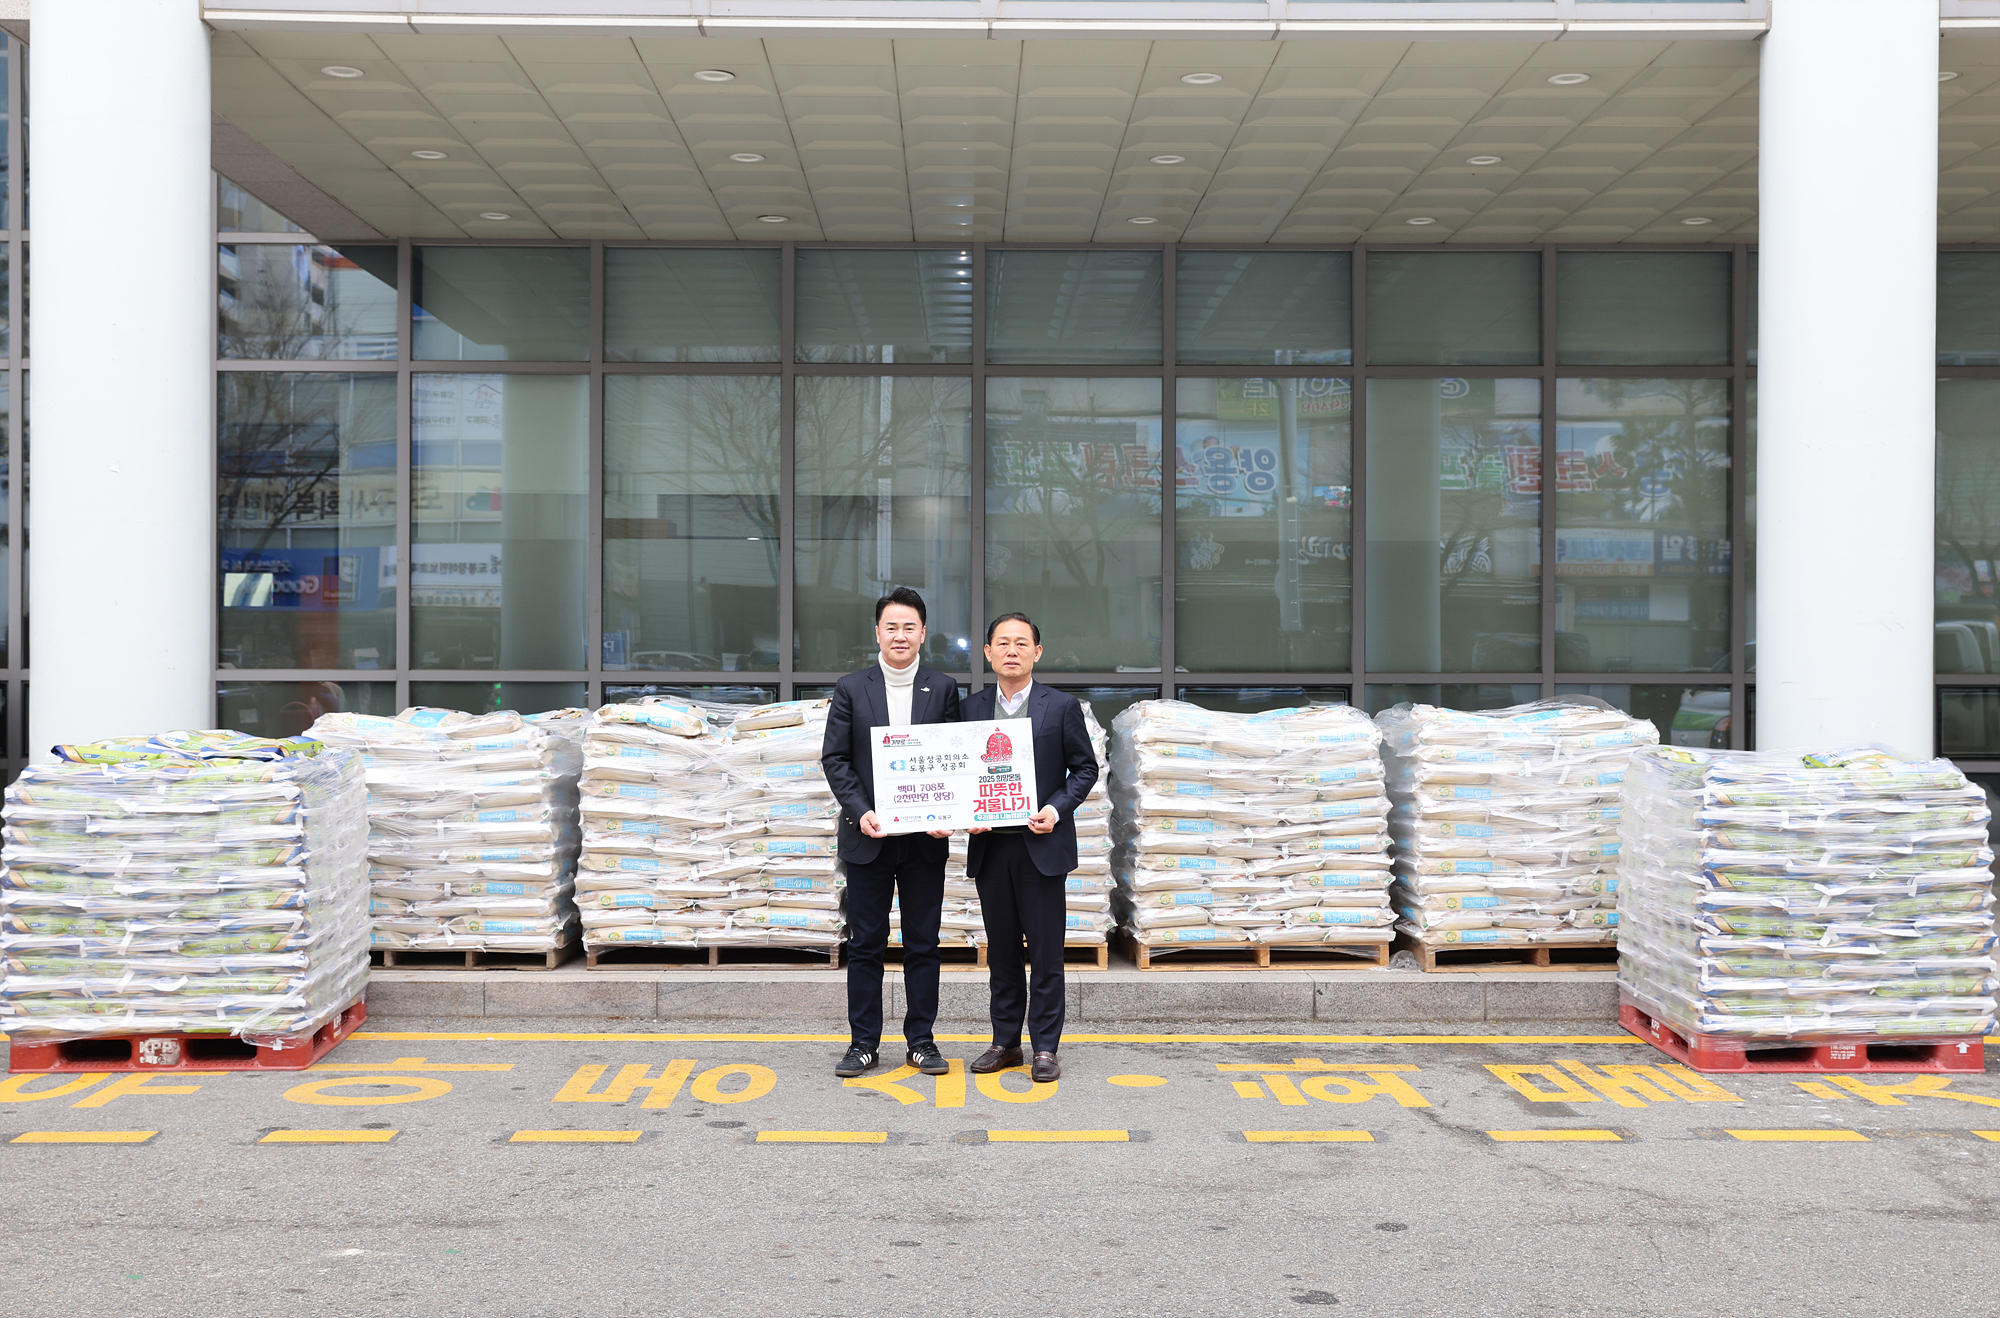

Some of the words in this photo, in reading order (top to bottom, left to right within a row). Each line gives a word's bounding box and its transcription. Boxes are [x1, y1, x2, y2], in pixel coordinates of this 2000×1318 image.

[909, 754, 969, 764] 서울상공회의소
[910, 764, 935, 773] 도봉구
[941, 762, 966, 771] 상공회
[979, 775, 995, 783] 2025
[897, 784, 916, 793] 백미
[920, 782, 946, 791] 708포
[979, 782, 1022, 798] 따뜻한
[893, 793, 929, 803] (2천만원
[933, 791, 954, 802] 상당)
[973, 796, 1030, 813] 겨울나기
